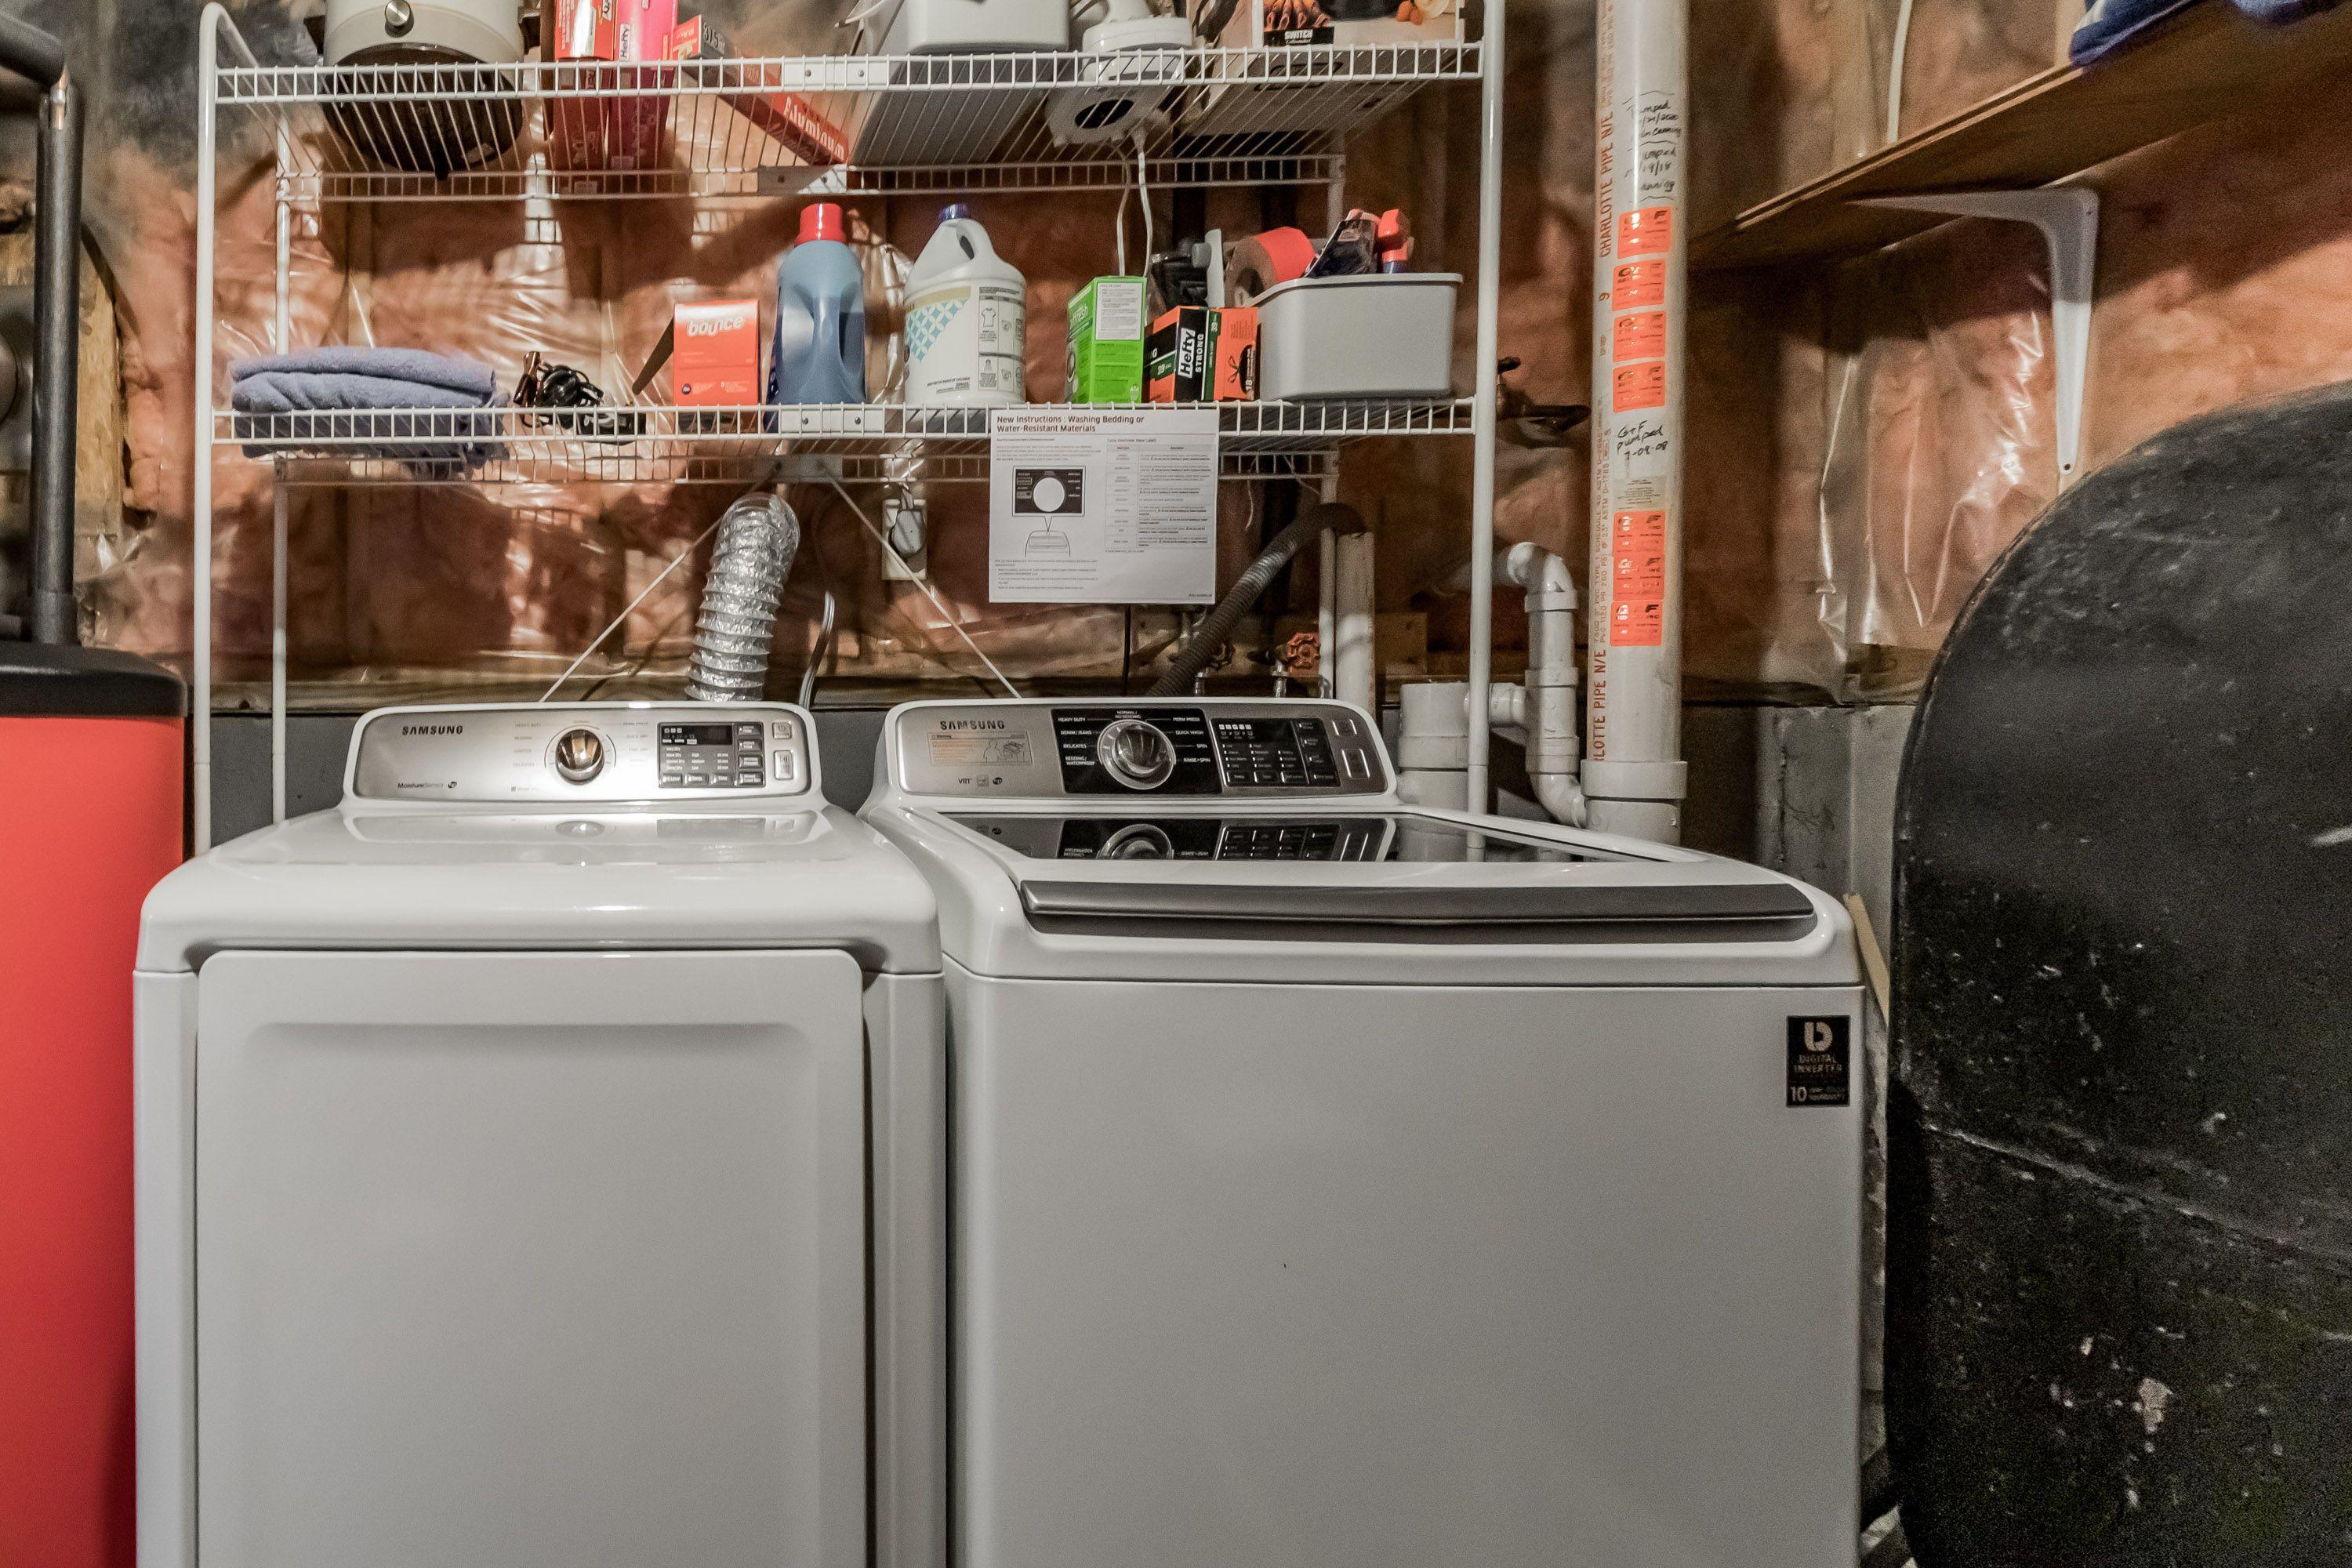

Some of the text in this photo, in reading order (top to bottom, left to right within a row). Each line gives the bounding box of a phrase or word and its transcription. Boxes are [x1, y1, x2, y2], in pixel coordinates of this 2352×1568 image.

[1600, 111, 1613, 140] N/E
[1600, 142, 1613, 176] PIPE
[1599, 177, 1613, 258] CHARLOTTE
[1179, 330, 1195, 376] Hefty
[1195, 334, 1204, 373] STRONG
[1068, 416, 1101, 424] Washing
[1102, 416, 1134, 424] Bedding
[1593, 649, 1606, 710] PIPE N/E
[401, 725, 463, 735] SAMSUNG
[939, 720, 1005, 730] SAMSUNG
[1790, 1086, 1808, 1102] 10
